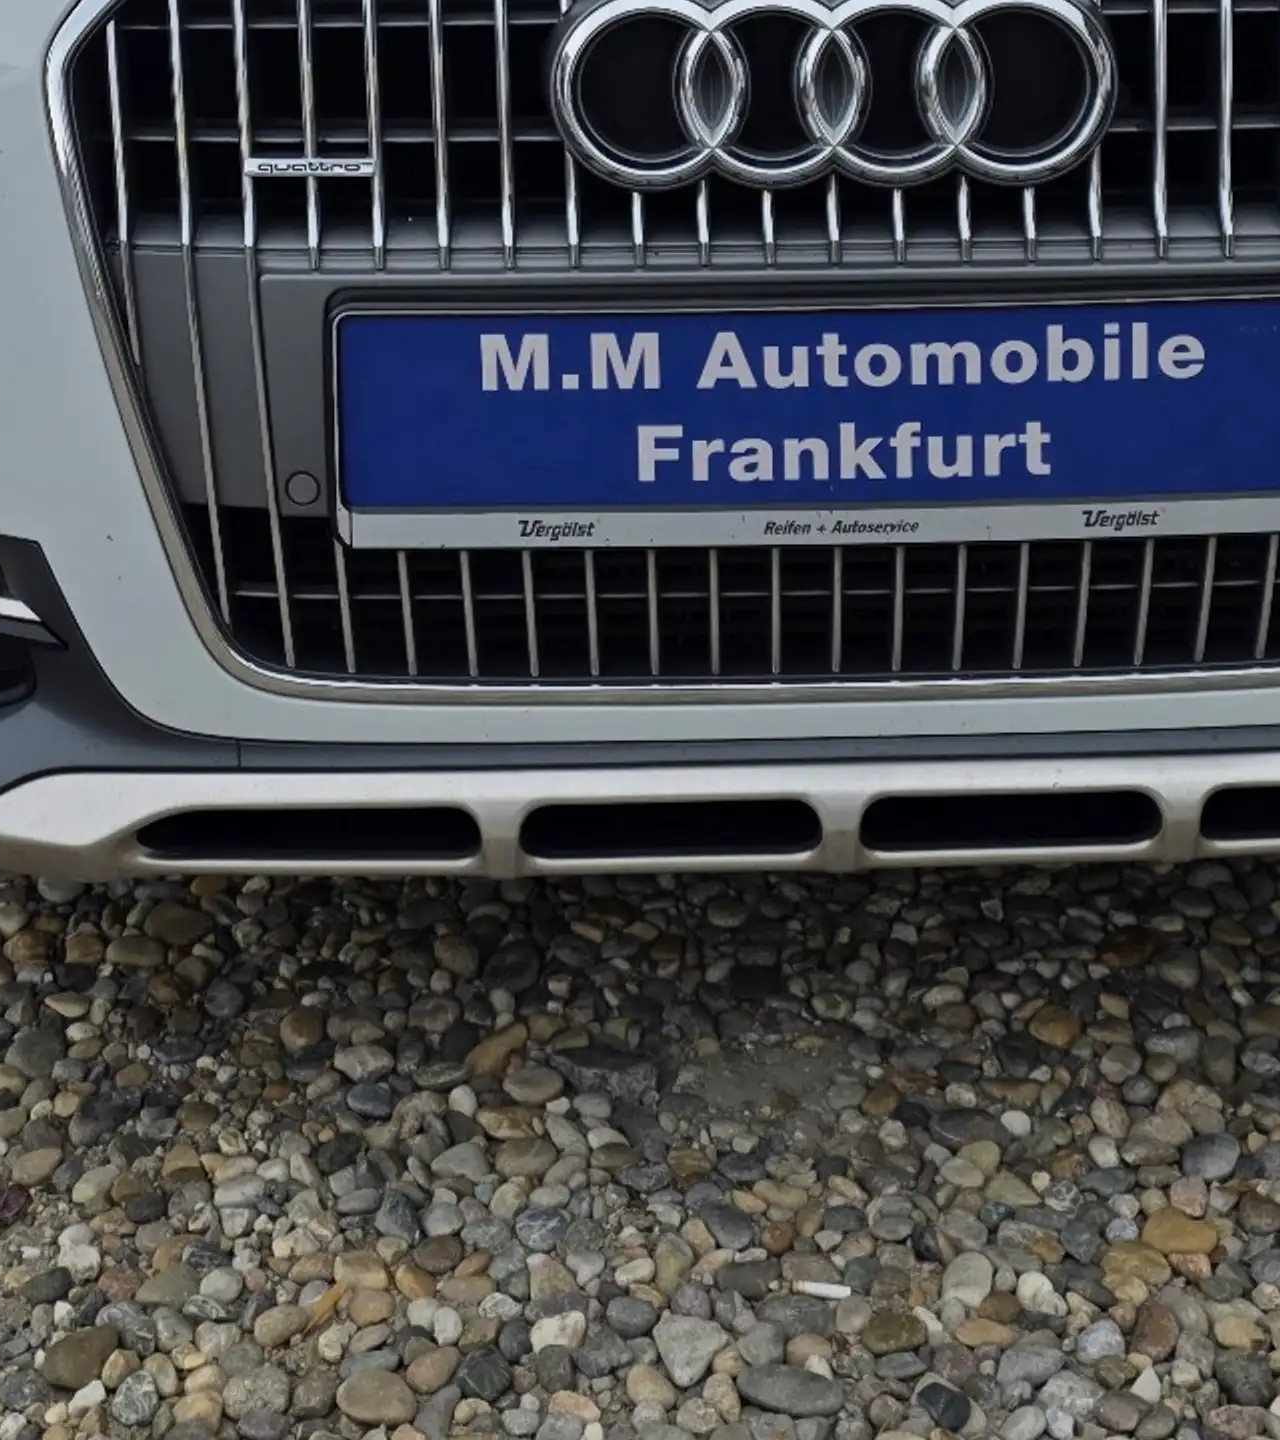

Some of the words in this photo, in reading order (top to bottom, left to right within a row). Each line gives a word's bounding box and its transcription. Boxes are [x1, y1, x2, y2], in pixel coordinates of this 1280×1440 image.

[257, 162, 361, 174] quattro
[479, 332, 661, 392] M.M
[696, 321, 1206, 390] Automobile
[637, 420, 1051, 482] Frankfurt
[518, 519, 595, 541] Vergölst
[763, 519, 812, 536] Reifen
[830, 519, 920, 536] Autoservice
[1081, 509, 1160, 532] Vergölst
